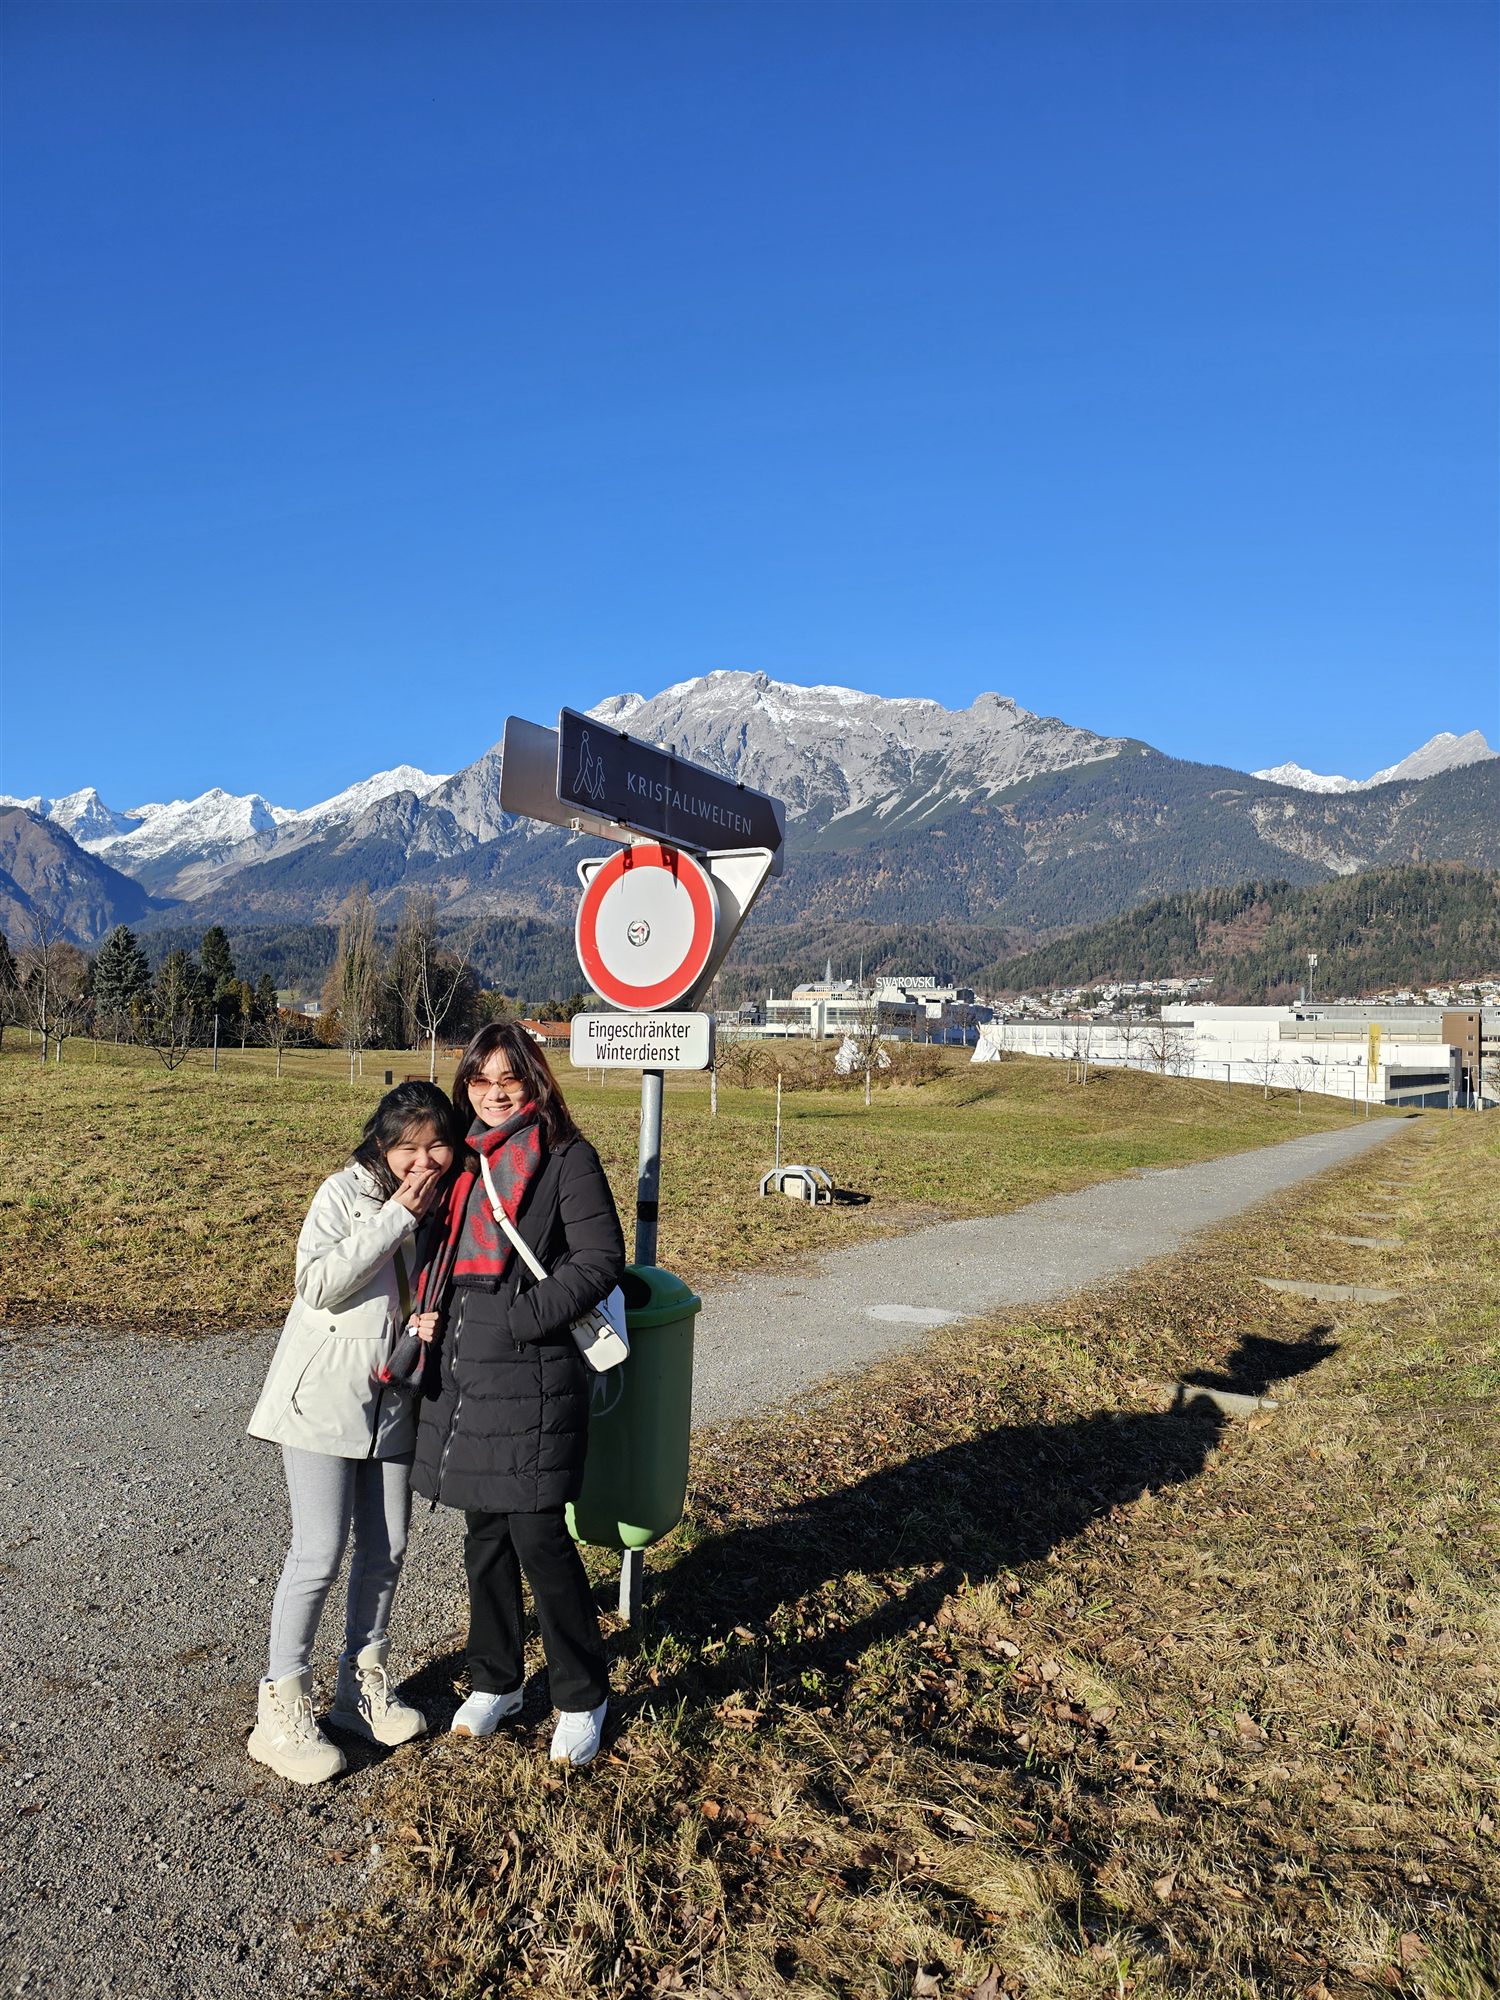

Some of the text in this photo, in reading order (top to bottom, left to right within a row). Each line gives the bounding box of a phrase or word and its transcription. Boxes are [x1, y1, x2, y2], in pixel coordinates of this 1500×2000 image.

[627, 771, 752, 836] KRISTALLWELTEN
[875, 976, 936, 988] SWAROVSKI
[588, 1020, 691, 1042] Eingeschränkter
[596, 1043, 681, 1061] Winterdienst
